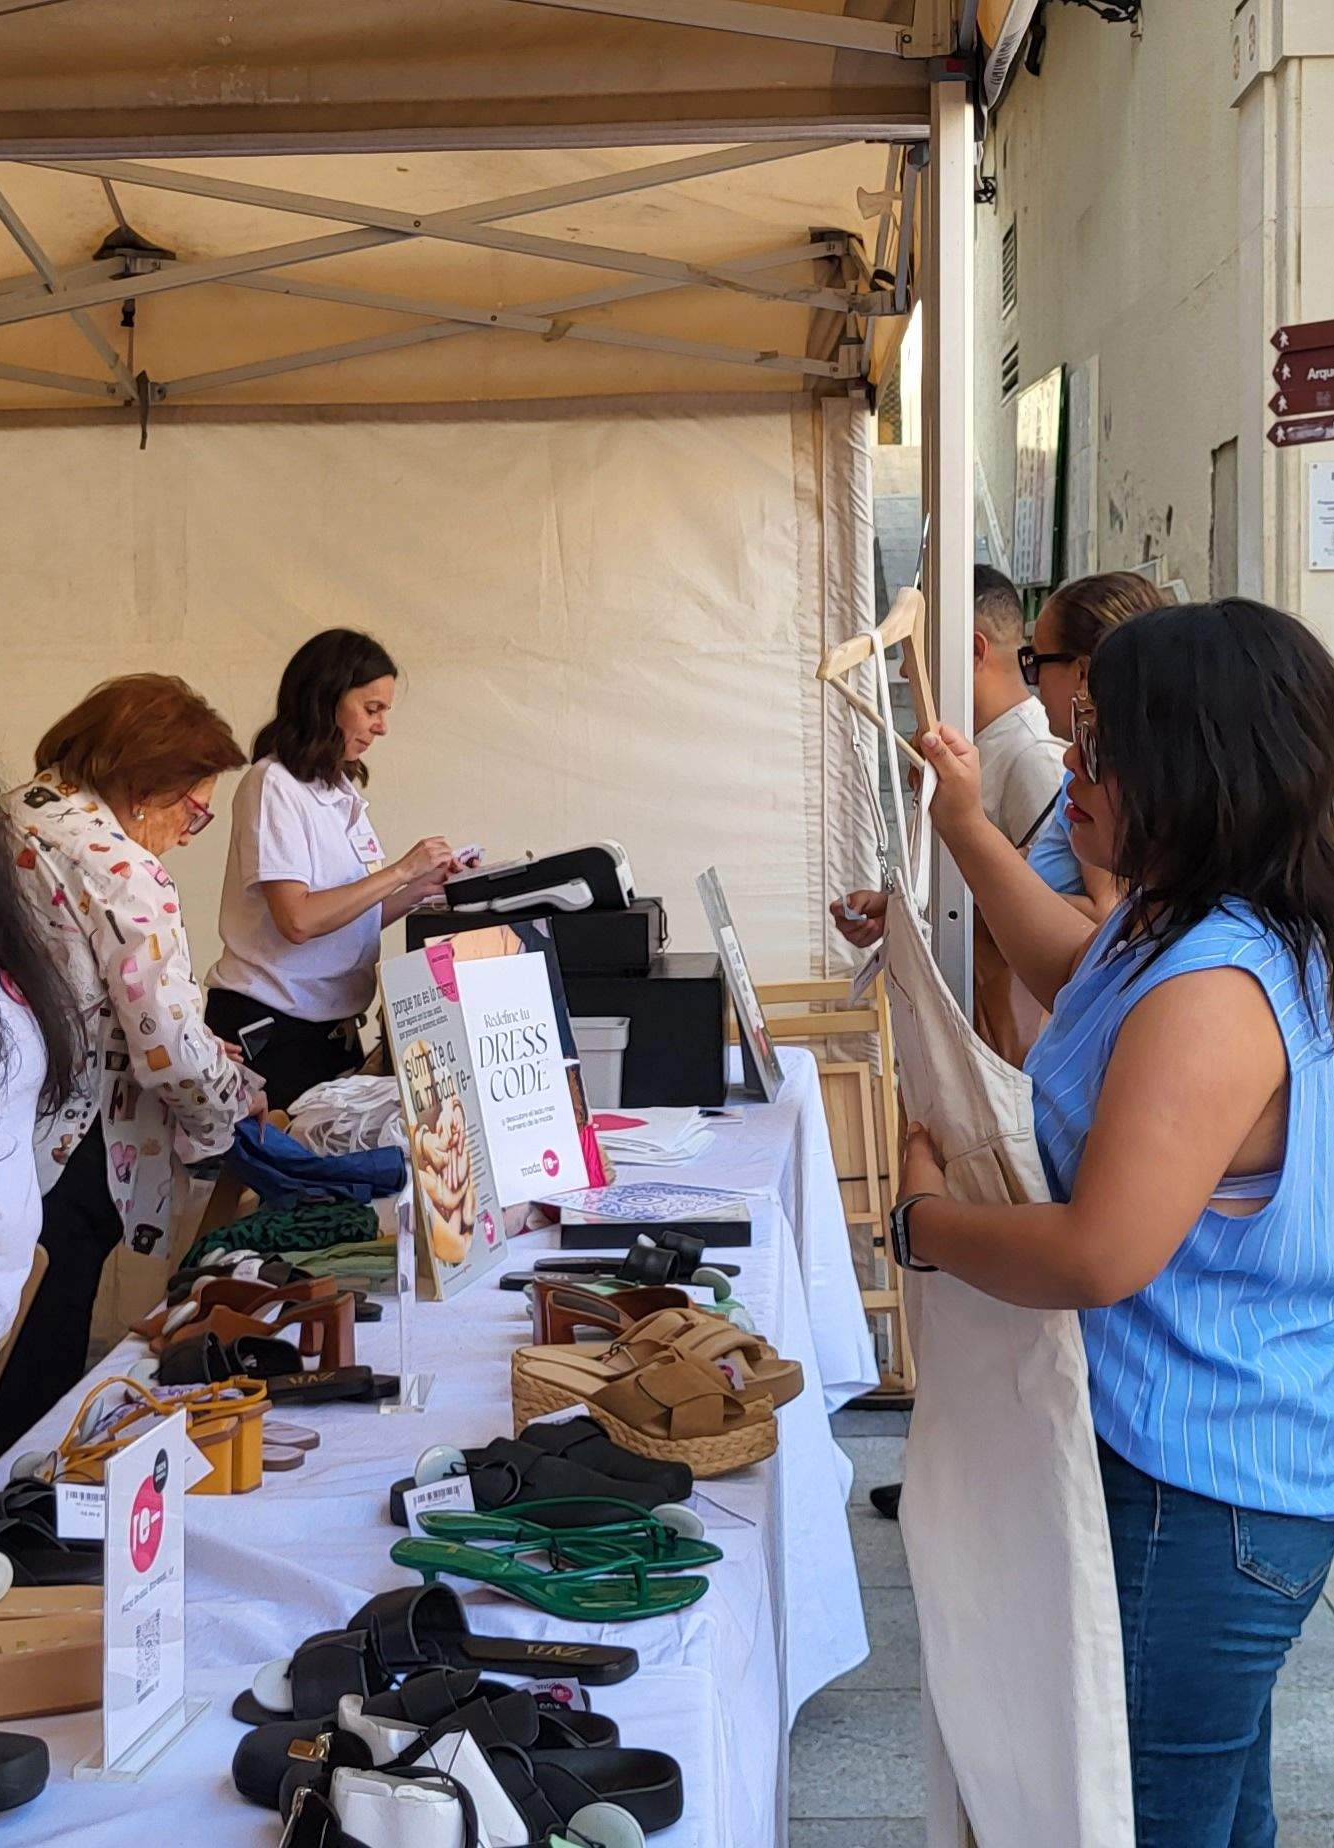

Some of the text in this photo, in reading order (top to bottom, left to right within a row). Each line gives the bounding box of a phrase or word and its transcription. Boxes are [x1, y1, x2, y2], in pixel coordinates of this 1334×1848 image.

[483, 1008, 531, 1029] Redefine tu
[447, 1040, 457, 1063] a
[478, 1022, 549, 1068] DRESS
[489, 1058, 551, 1103] CODE
[520, 1161, 542, 1177] moda
